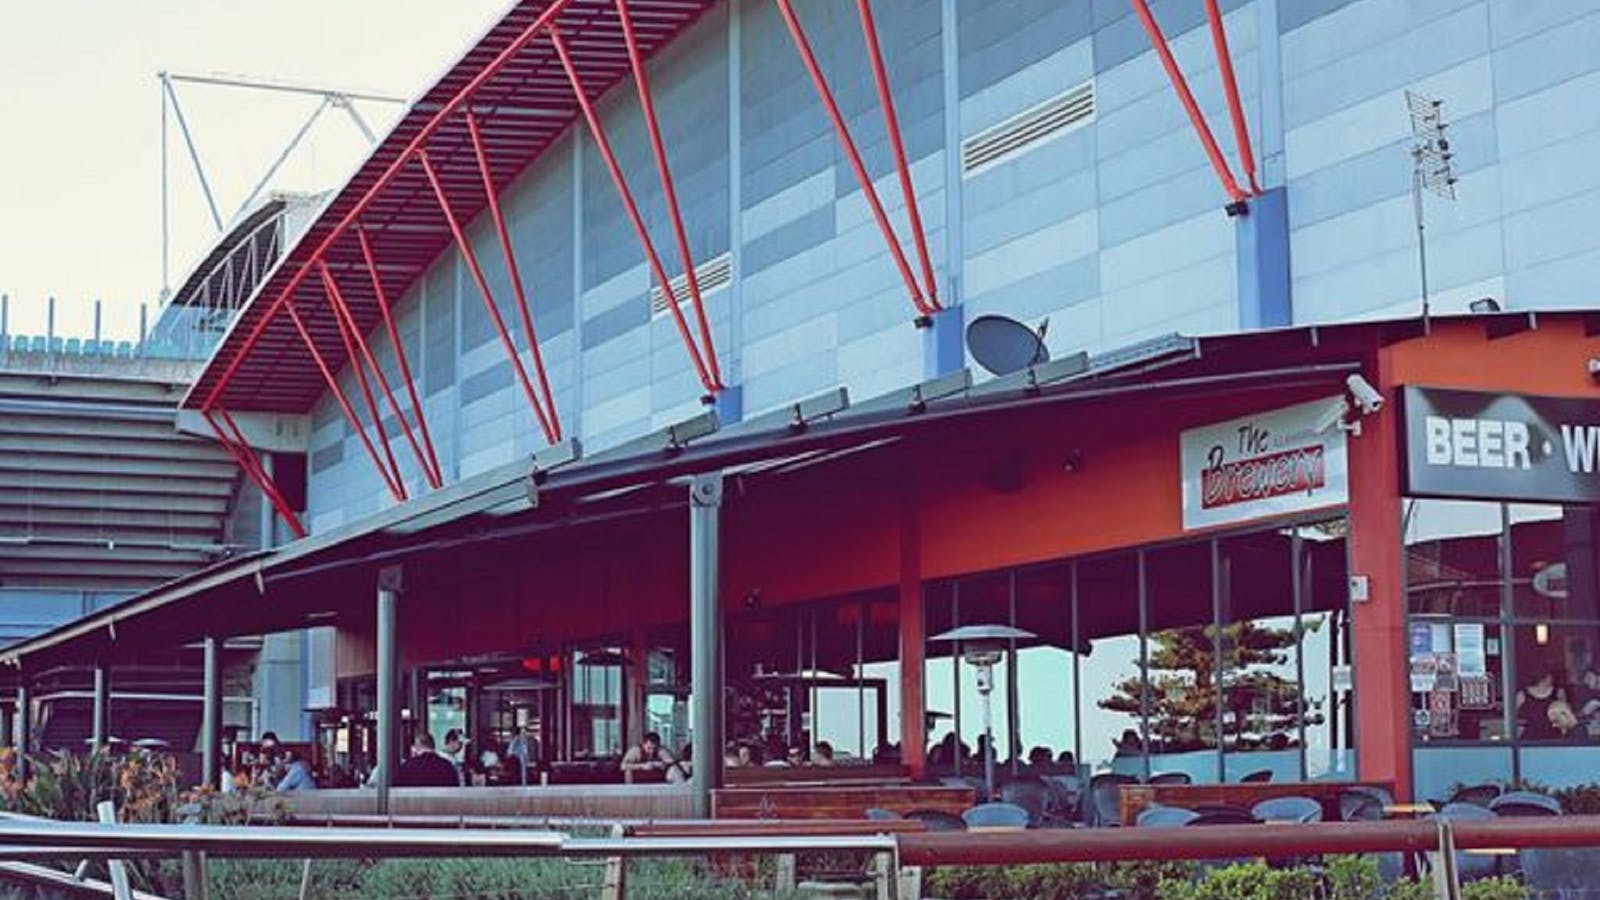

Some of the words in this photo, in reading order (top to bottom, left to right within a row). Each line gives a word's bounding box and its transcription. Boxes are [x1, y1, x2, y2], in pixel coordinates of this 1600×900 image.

[1238, 423, 1268, 454] The
[1426, 416, 1531, 470] BEER
[1204, 445, 1322, 504] Brewery
